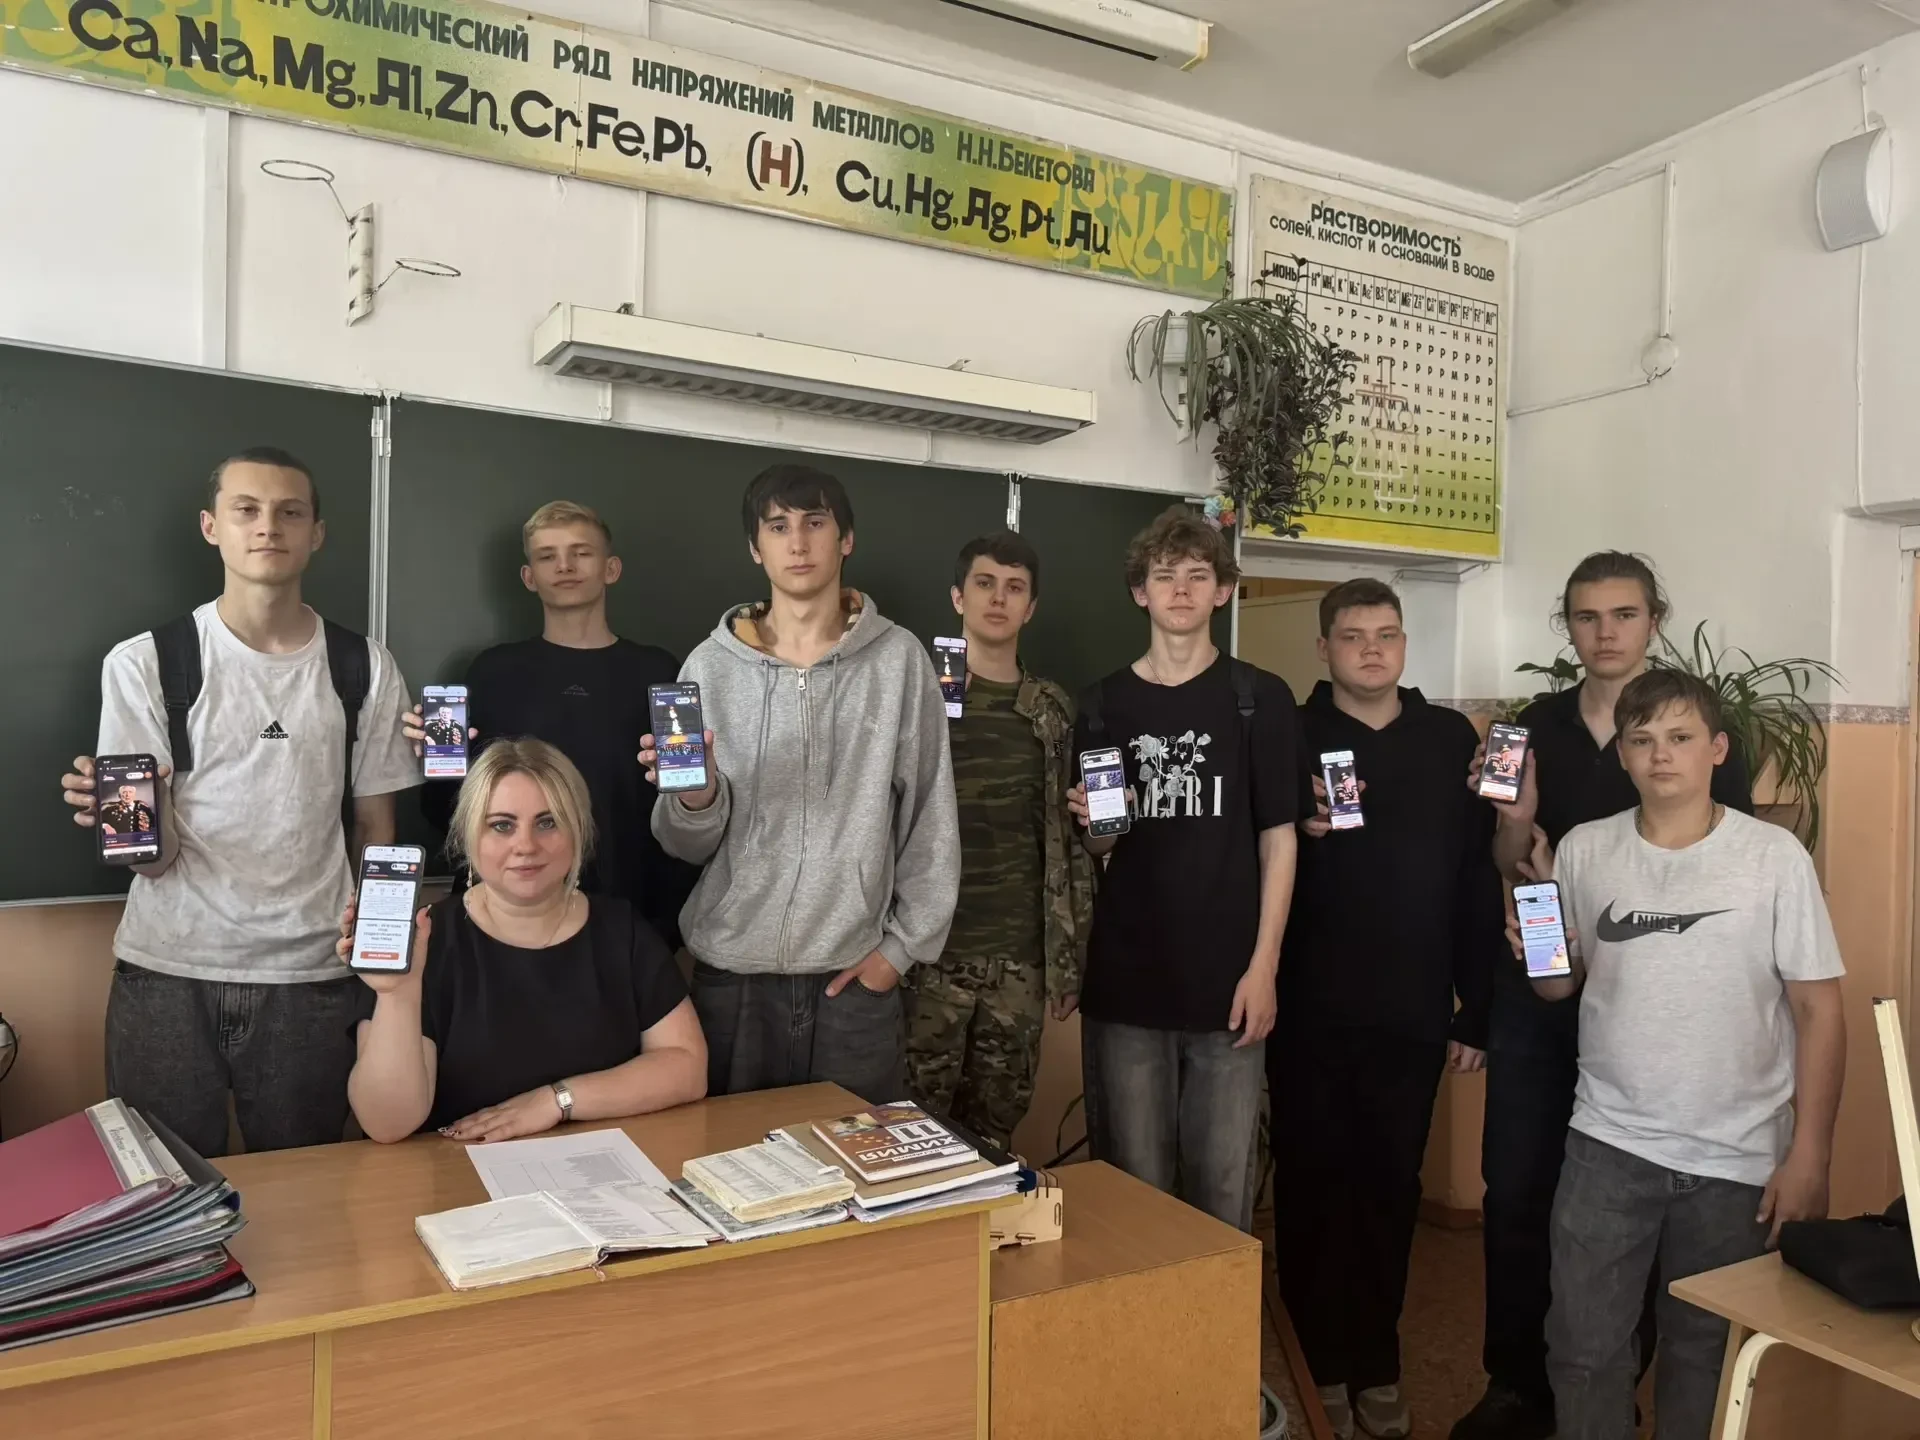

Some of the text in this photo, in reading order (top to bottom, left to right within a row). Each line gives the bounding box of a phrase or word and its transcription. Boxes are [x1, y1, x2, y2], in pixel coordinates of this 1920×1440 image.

[553, 39, 611, 81] РЯД
[632, 57, 794, 122] НАПРЯЖЕНИЙ
[813, 101, 934, 154] МЕТАЛЛОВ
[1311, 203, 1461, 257] РАСТВОРИМОСТЬ
[1637, 914, 1677, 930] NIKE
[861, 1136, 957, 1161] ХИМИЯ
